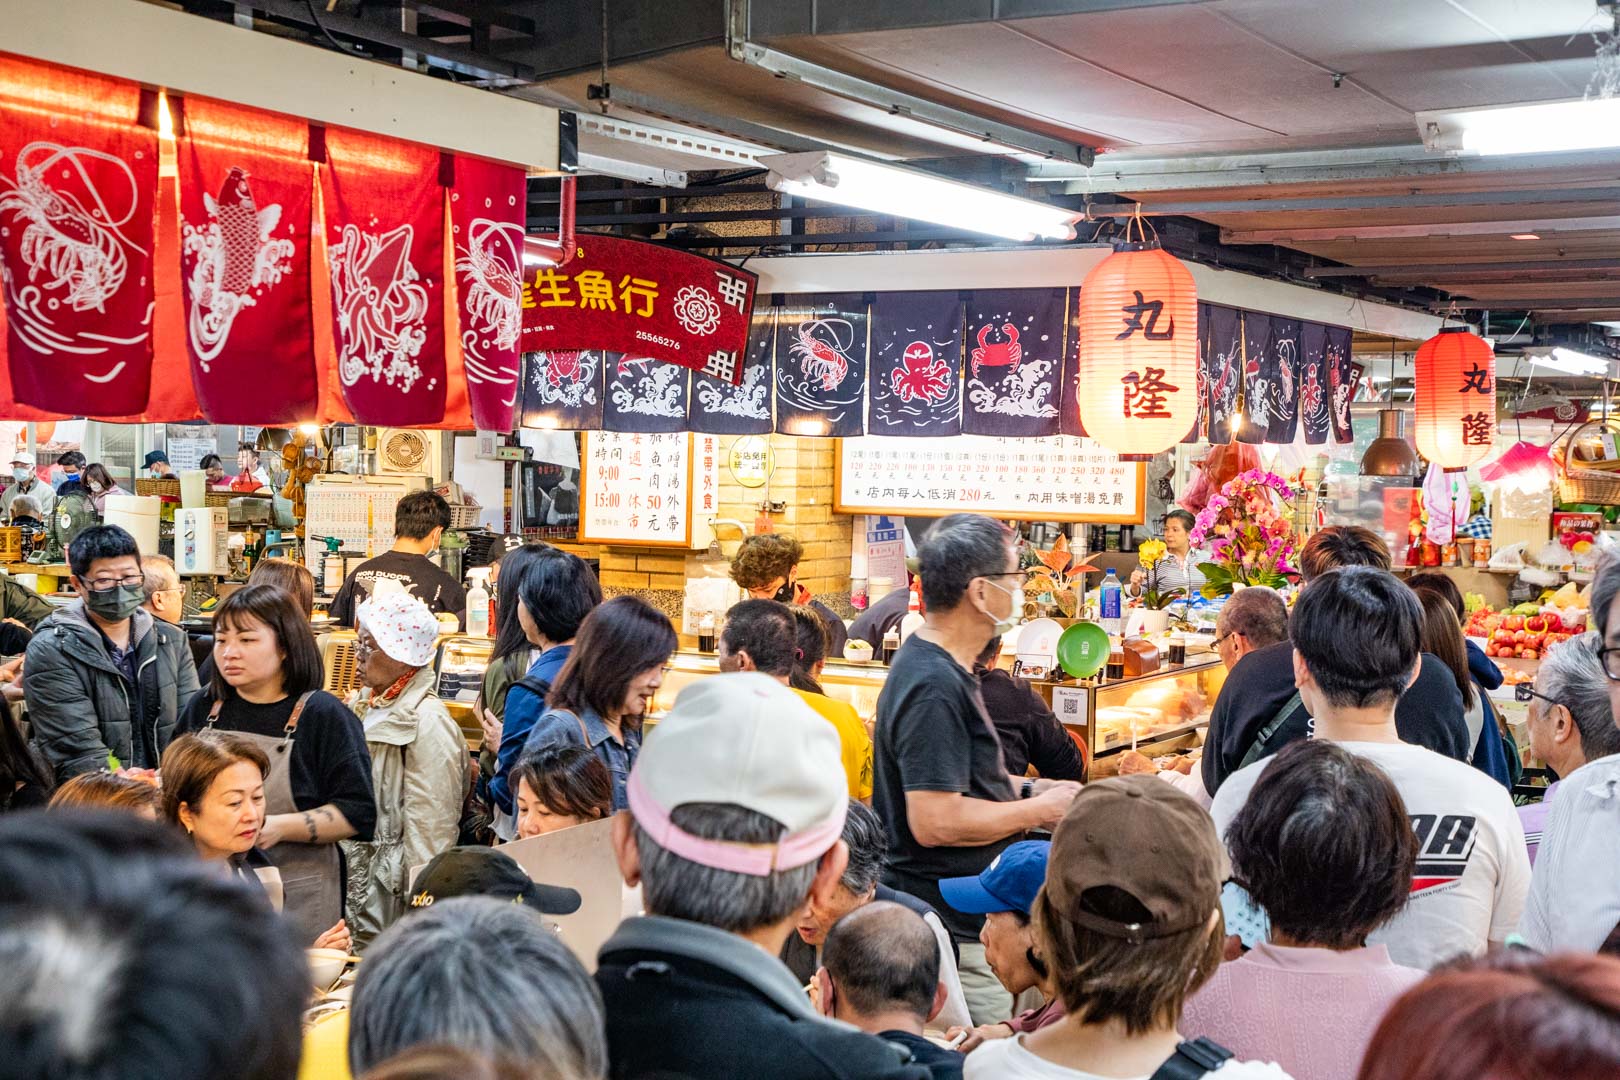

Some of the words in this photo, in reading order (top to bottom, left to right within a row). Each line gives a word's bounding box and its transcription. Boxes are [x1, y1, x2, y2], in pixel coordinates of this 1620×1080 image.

[635, 330, 681, 350] 25565276
[1115, 290, 1180, 420] 丸隆
[1458, 362, 1493, 446] 丸隆
[595, 447, 622, 461] 時間
[598, 465, 619, 480] 9:00
[703, 437, 713, 510] 禁帶外食
[595, 492, 620, 507] 15:00
[411, 890, 434, 906] XXIO
